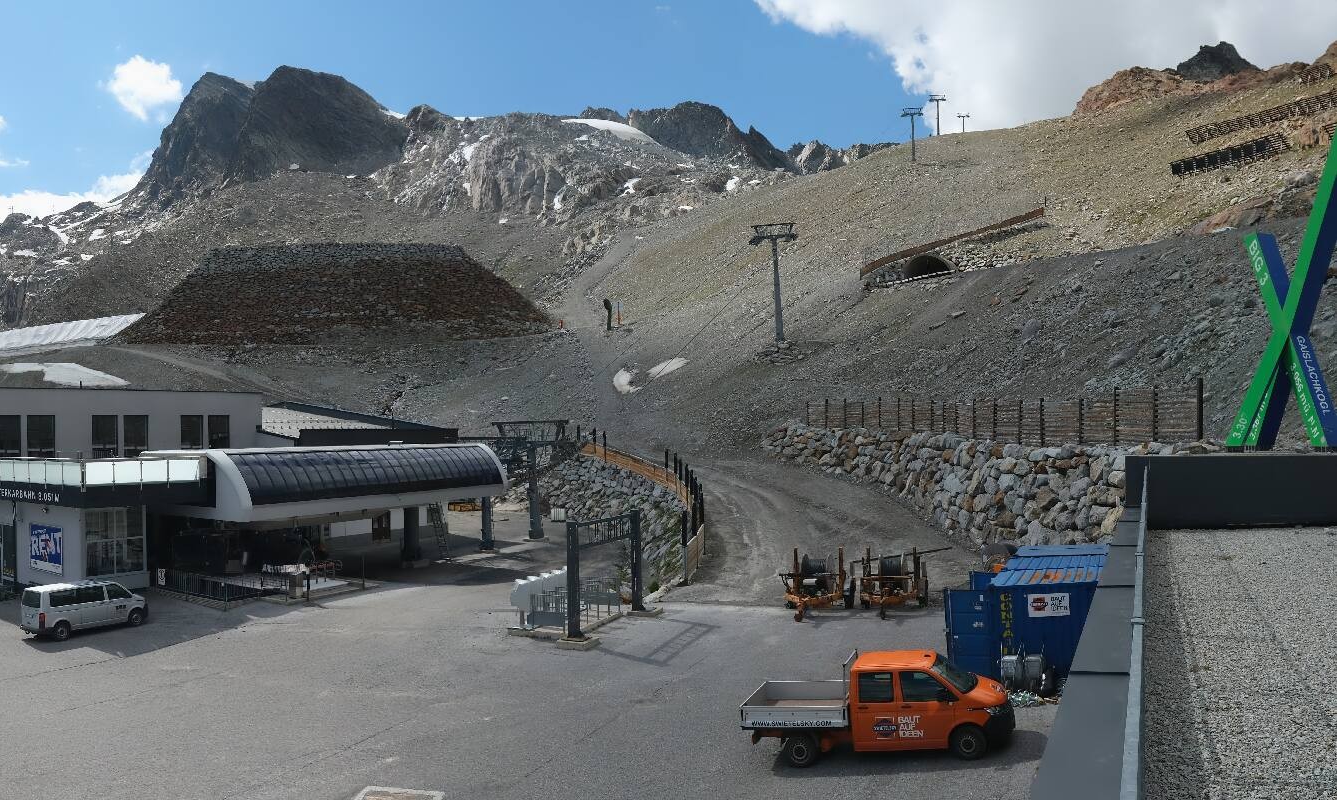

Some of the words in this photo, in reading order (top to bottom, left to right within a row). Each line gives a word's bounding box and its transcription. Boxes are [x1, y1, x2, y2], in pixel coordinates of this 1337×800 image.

[1249, 239, 1264, 272] BIG
[1259, 272, 1268, 286] 3
[1296, 335, 1330, 416] GAISLACHKOGL
[751, 719, 832, 727] WWW.SWIETELSKY.COM
[897, 715, 921, 724] BAUT
[899, 723, 916, 731] AUF
[898, 729, 925, 738] IDEEN
